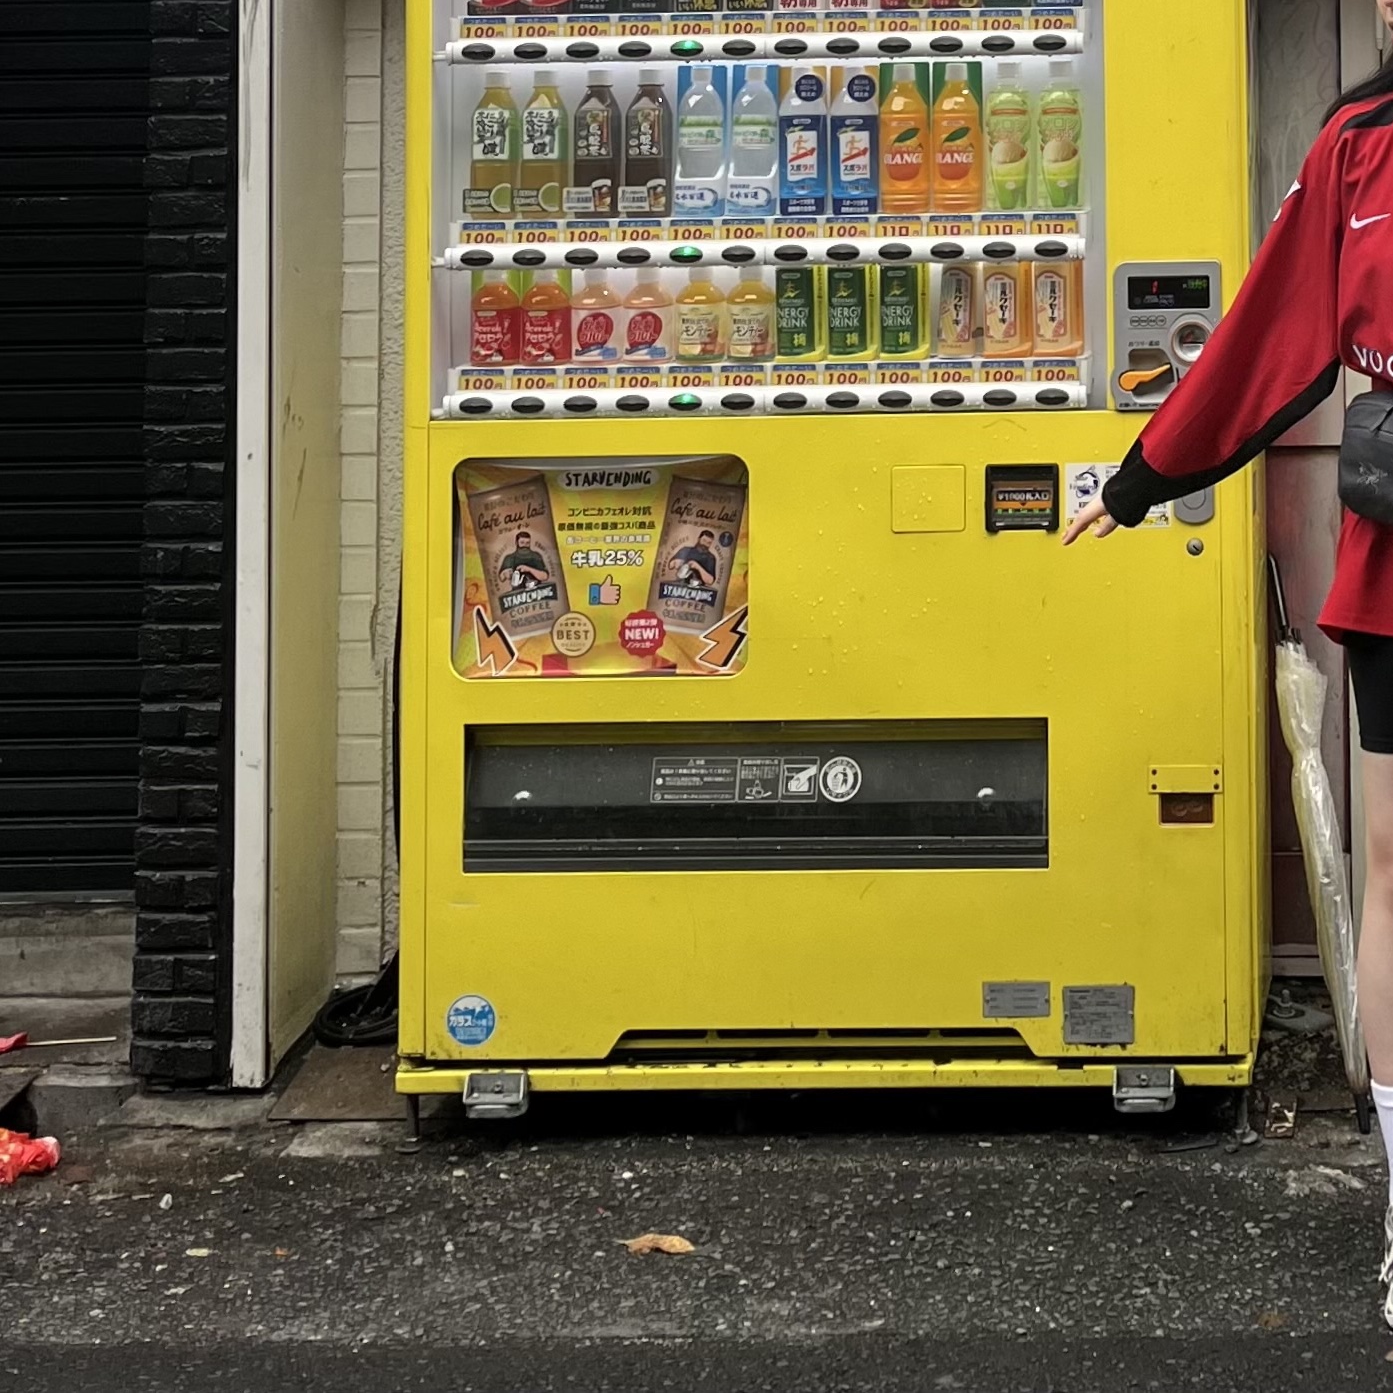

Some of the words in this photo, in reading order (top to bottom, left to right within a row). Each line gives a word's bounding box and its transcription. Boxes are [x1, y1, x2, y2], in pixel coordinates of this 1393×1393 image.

[565, 470, 652, 487] STARVENDING
[670, 497, 695, 520] Café
[696, 508, 715, 520] au
[477, 512, 501, 532] Café
[503, 512, 523, 525] au
[571, 549, 644, 567] 牛乳25%
[502, 586, 554, 608] STARVENDING
[663, 584, 714, 602] STARVENDING
[509, 601, 552, 619] COFFEE
[557, 630, 589, 640] BEST
[625, 628, 659, 640] NEW!
